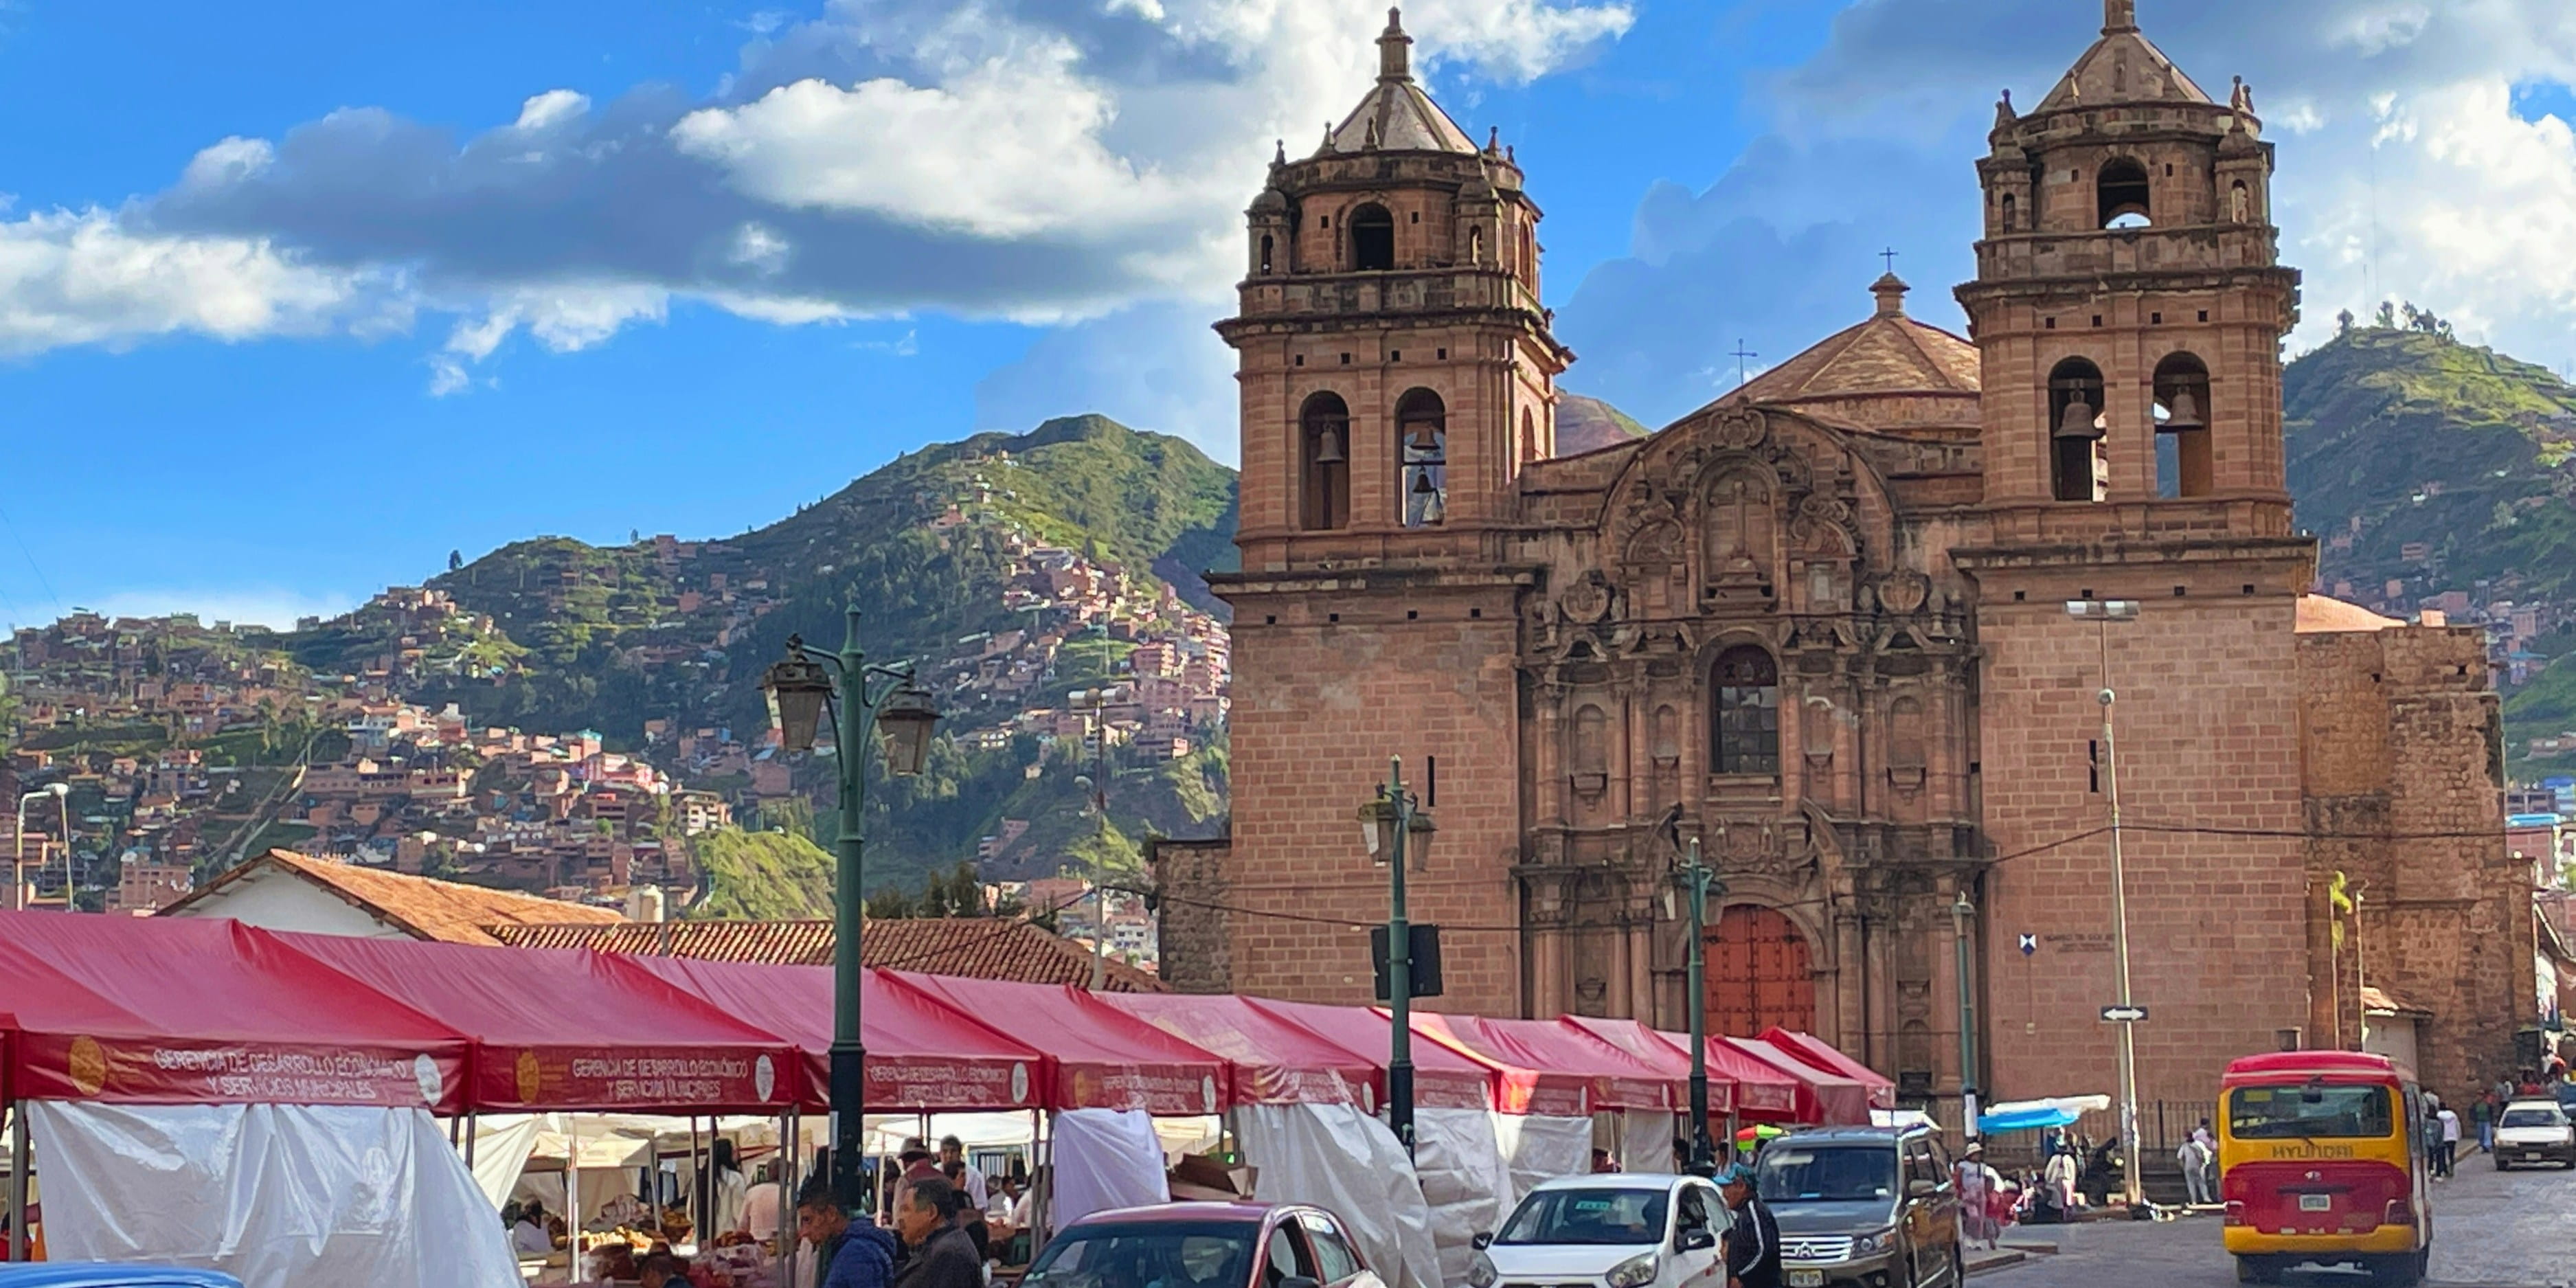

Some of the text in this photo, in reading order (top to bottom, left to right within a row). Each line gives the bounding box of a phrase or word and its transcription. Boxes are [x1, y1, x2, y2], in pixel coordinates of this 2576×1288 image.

[153, 1048, 227, 1072] GERENCIA
[229, 1051, 248, 1073] DE
[207, 1076, 218, 1095] Y
[220, 1076, 295, 1097] SERVICIOS
[2272, 1145, 2354, 1158] HYUNDAI
